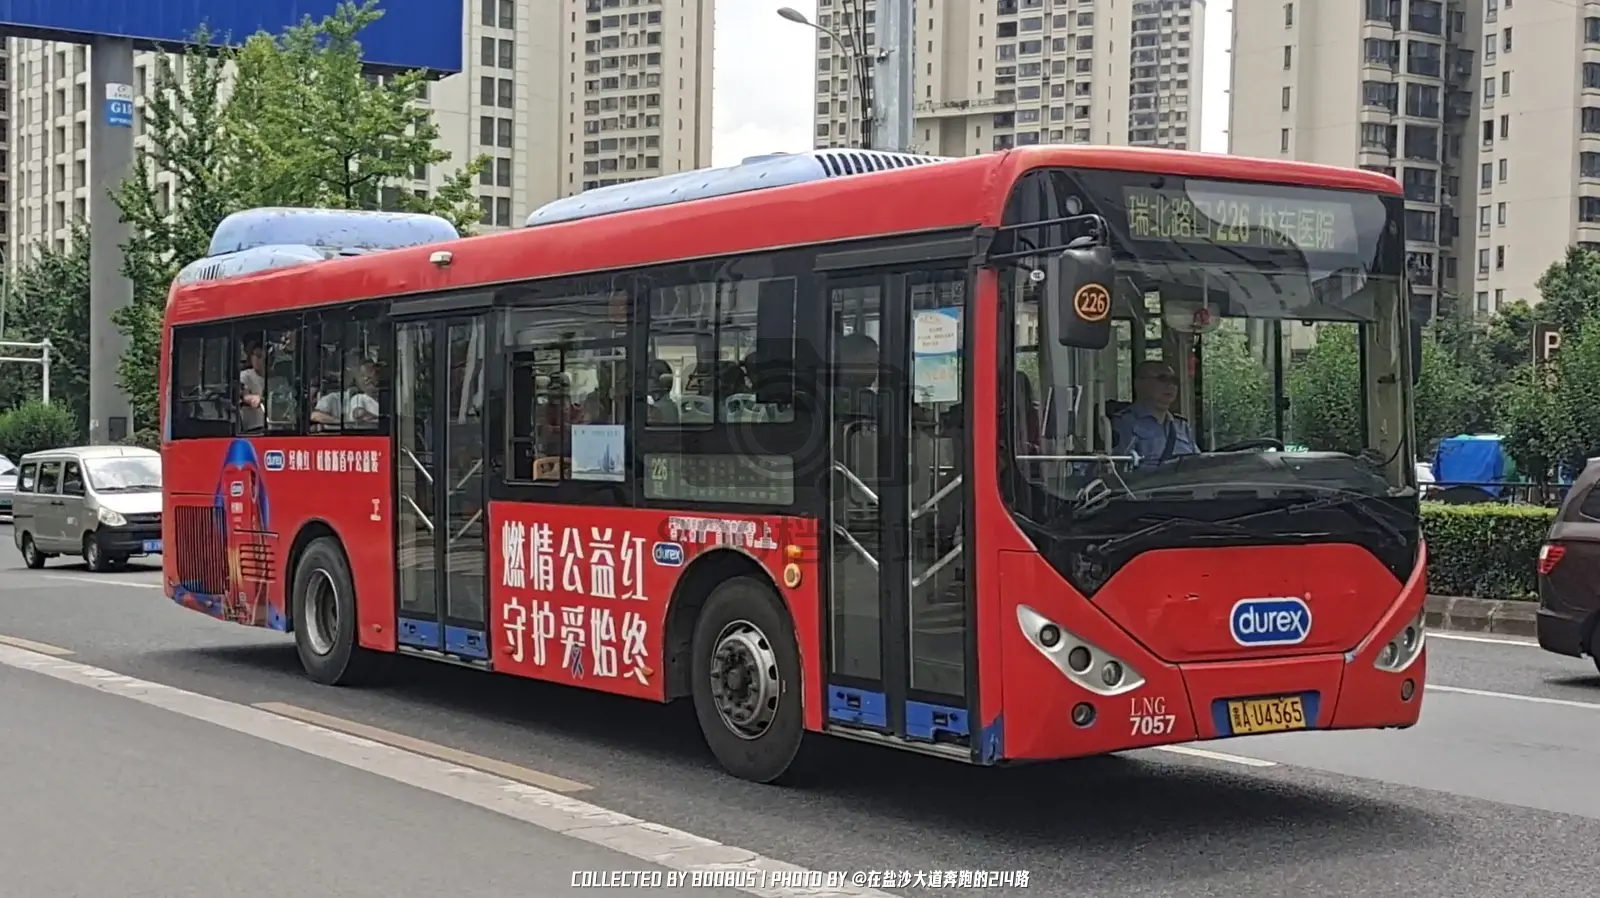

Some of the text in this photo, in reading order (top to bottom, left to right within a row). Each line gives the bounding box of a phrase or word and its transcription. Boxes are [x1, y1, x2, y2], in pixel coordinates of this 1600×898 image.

[1129, 195, 1335, 249] 瑞北路口 226 林东医院
[1080, 292, 1106, 313] 226
[1544, 331, 1561, 359] P
[502, 520, 648, 601] 燃情公益红
[1239, 605, 1304, 638] durex
[503, 597, 649, 686] 守护爱始终
[1130, 696, 1166, 716] LNG
[1130, 715, 1176, 736] 7057
